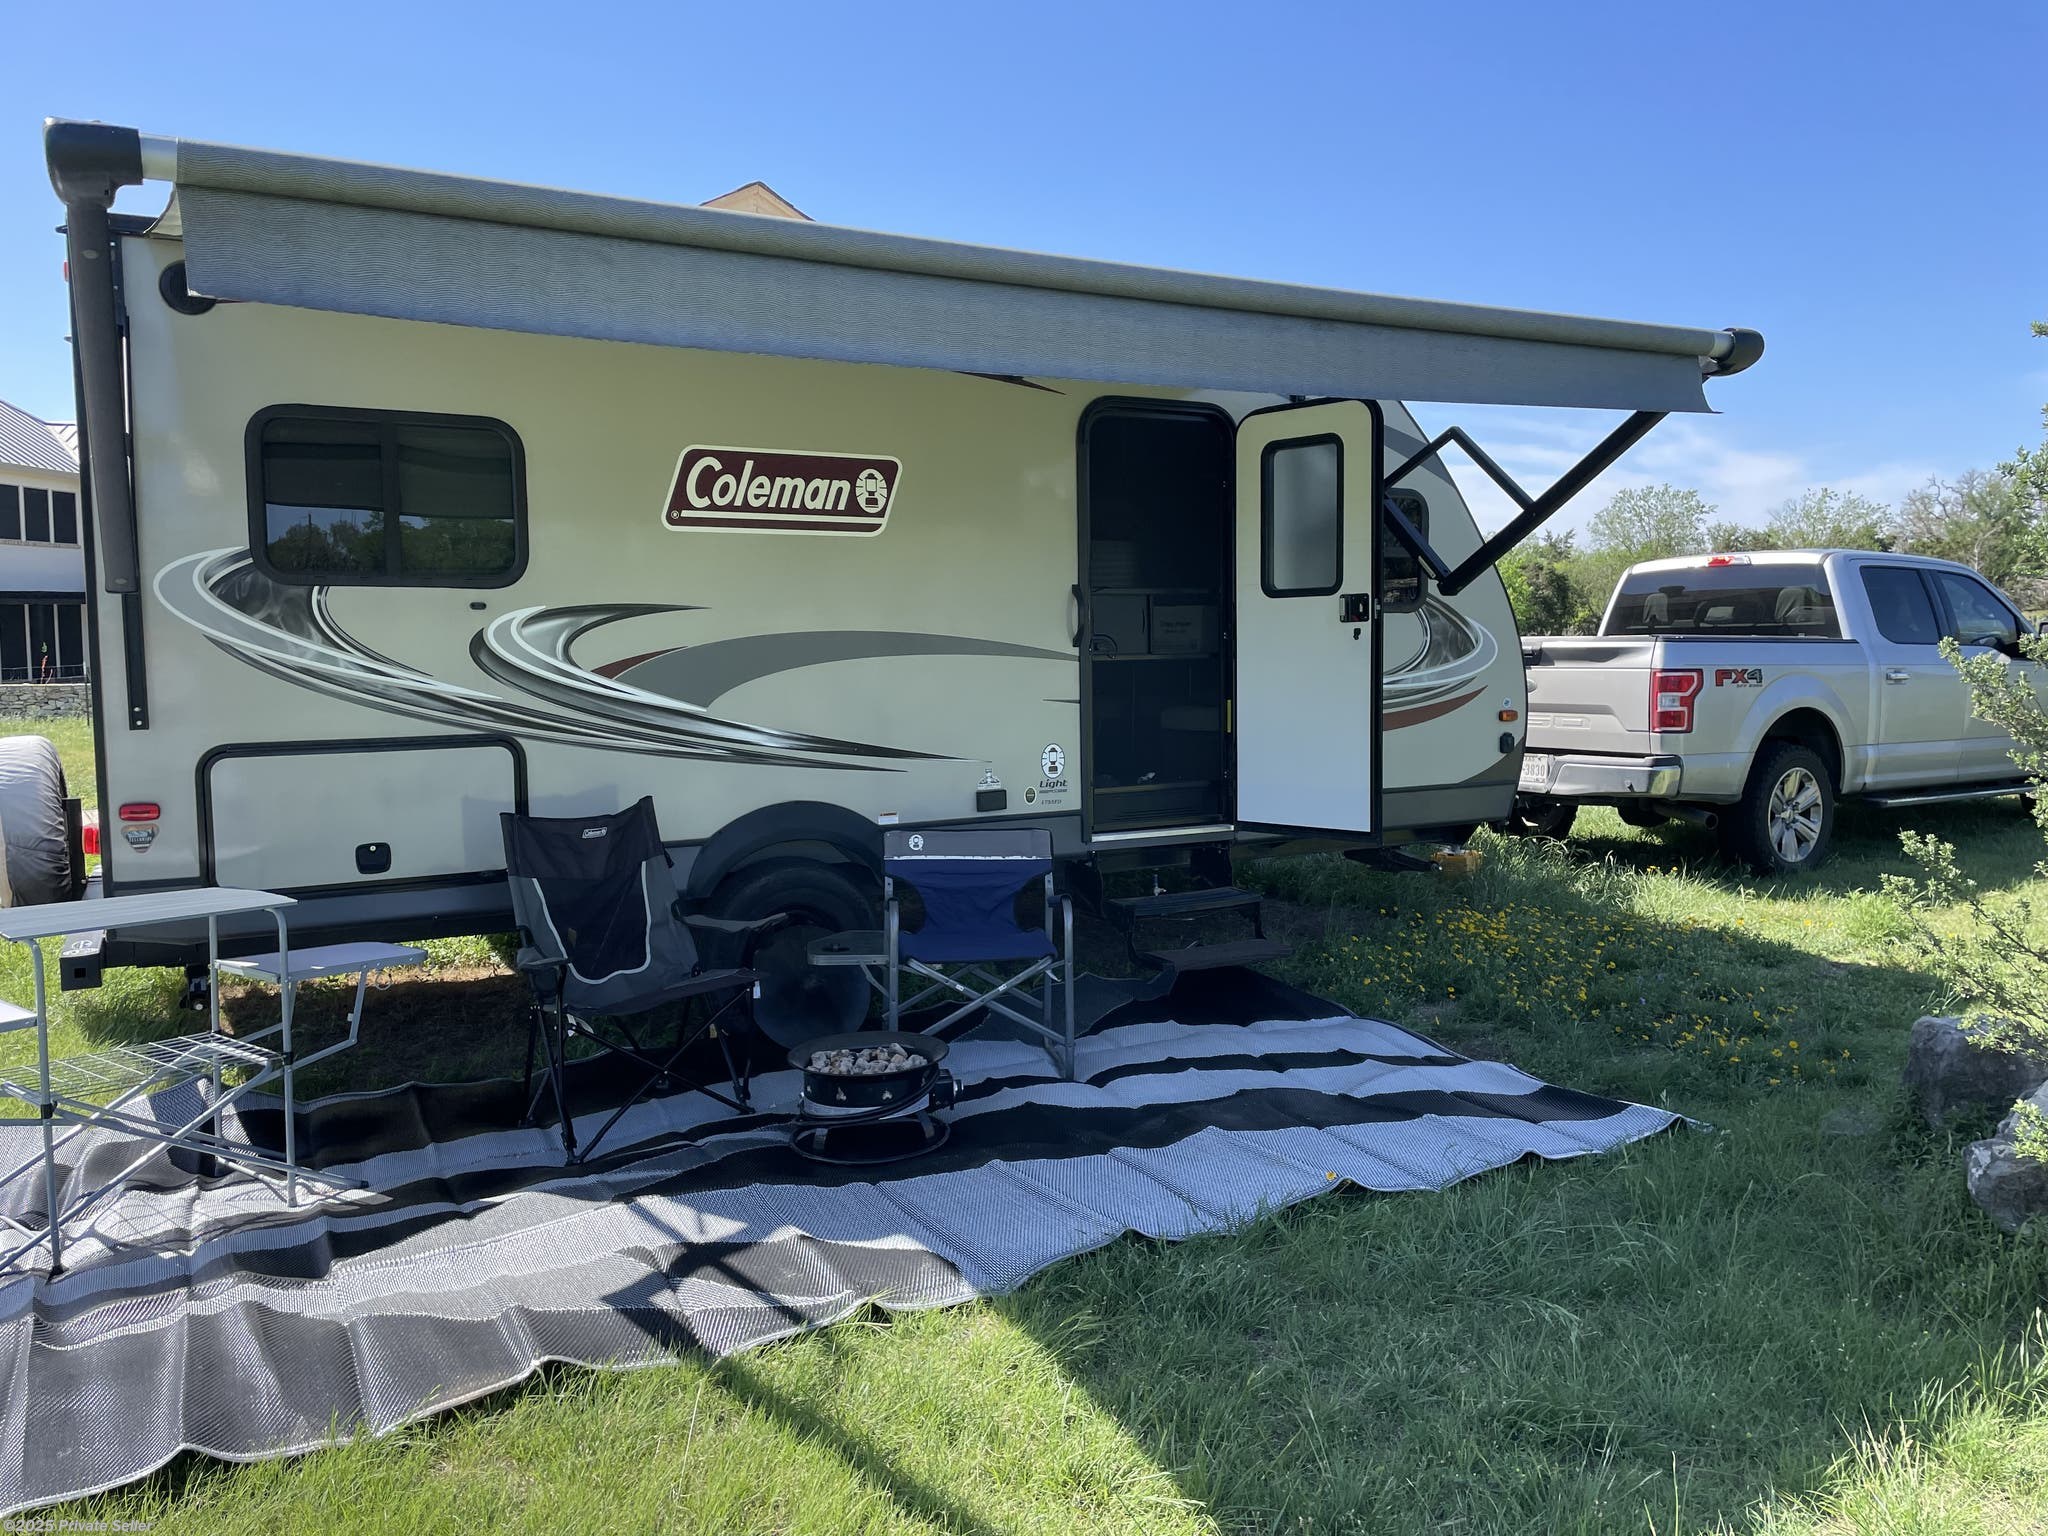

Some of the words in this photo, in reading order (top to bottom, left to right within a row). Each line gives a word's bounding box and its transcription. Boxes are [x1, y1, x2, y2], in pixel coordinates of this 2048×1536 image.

[686, 456, 851, 511] Coleman
[1715, 668, 1763, 687] FX4
[1039, 779, 1068, 789] Light
